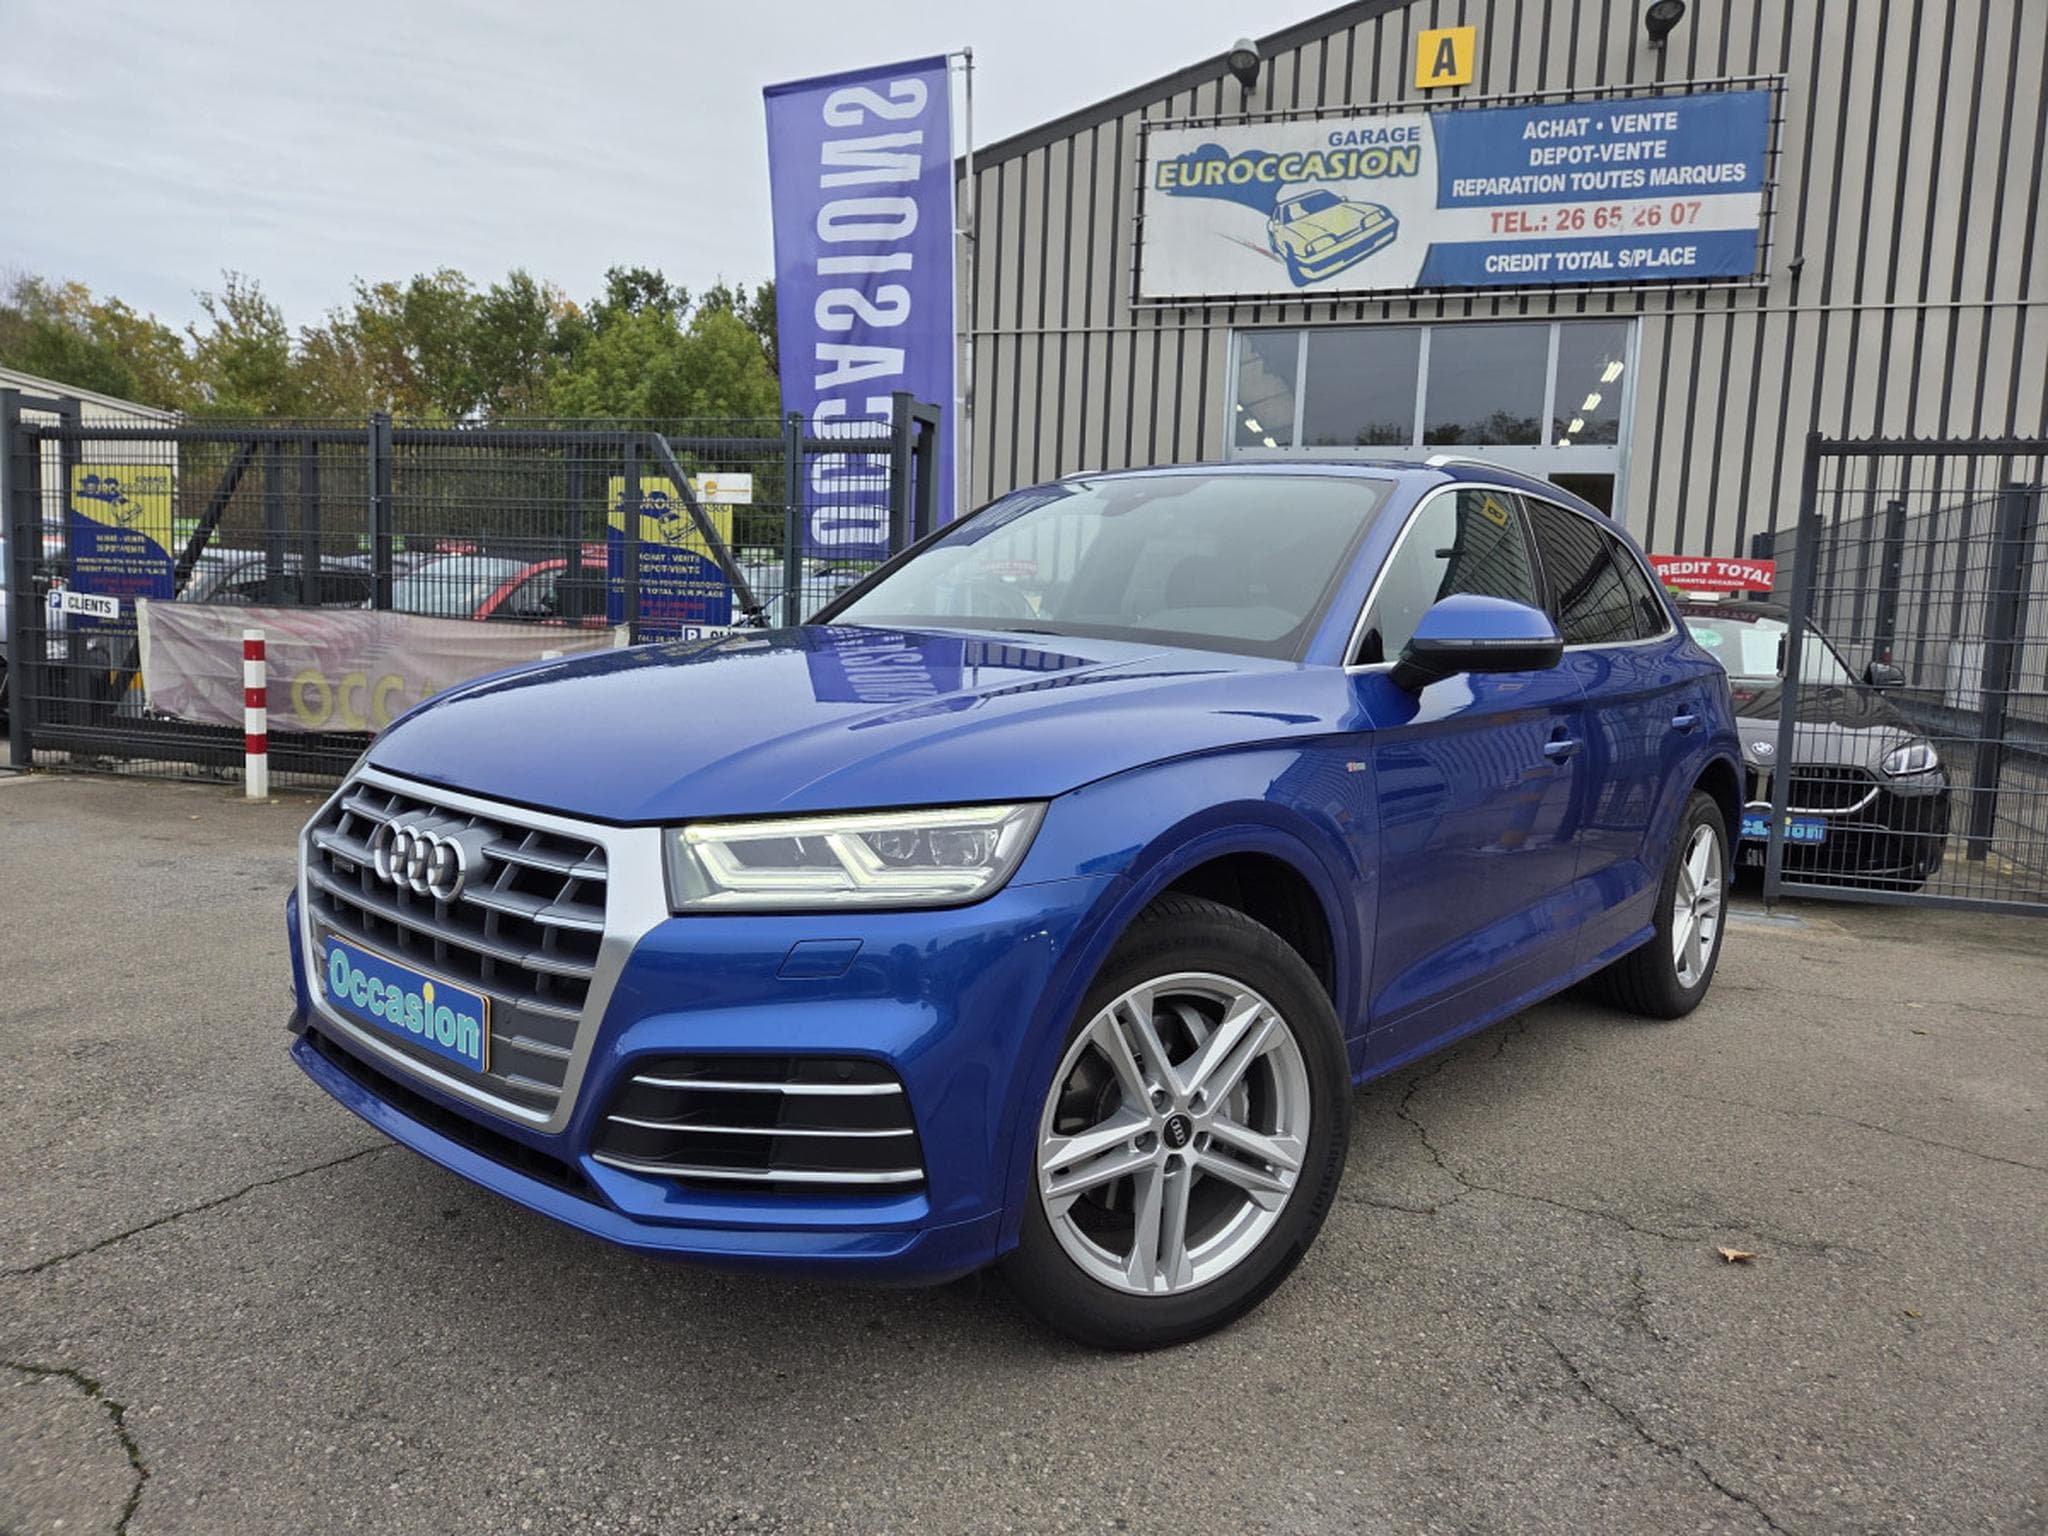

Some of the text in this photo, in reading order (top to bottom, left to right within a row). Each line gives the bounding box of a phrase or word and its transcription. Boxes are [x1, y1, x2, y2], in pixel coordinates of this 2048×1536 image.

[1430, 38, 1458, 77] A
[1328, 126, 1420, 146] GARAGE
[1523, 112, 1678, 140] ACHAT VENTE
[1529, 140, 1667, 167] DEPOT-VENTE
[1156, 146, 1420, 190] EUROCCASION
[1452, 163, 1747, 197] REPARATION TOUTES MARQUES
[1556, 208, 1585, 231] 26
[1671, 201, 1702, 225] 07
[1485, 246, 1697, 272] CREDIT TOTAL S/PLACE
[1653, 561, 1773, 585] REDIT TOTAL
[68, 597, 111, 613] CLIENTS
[329, 948, 480, 1060] Occasion
